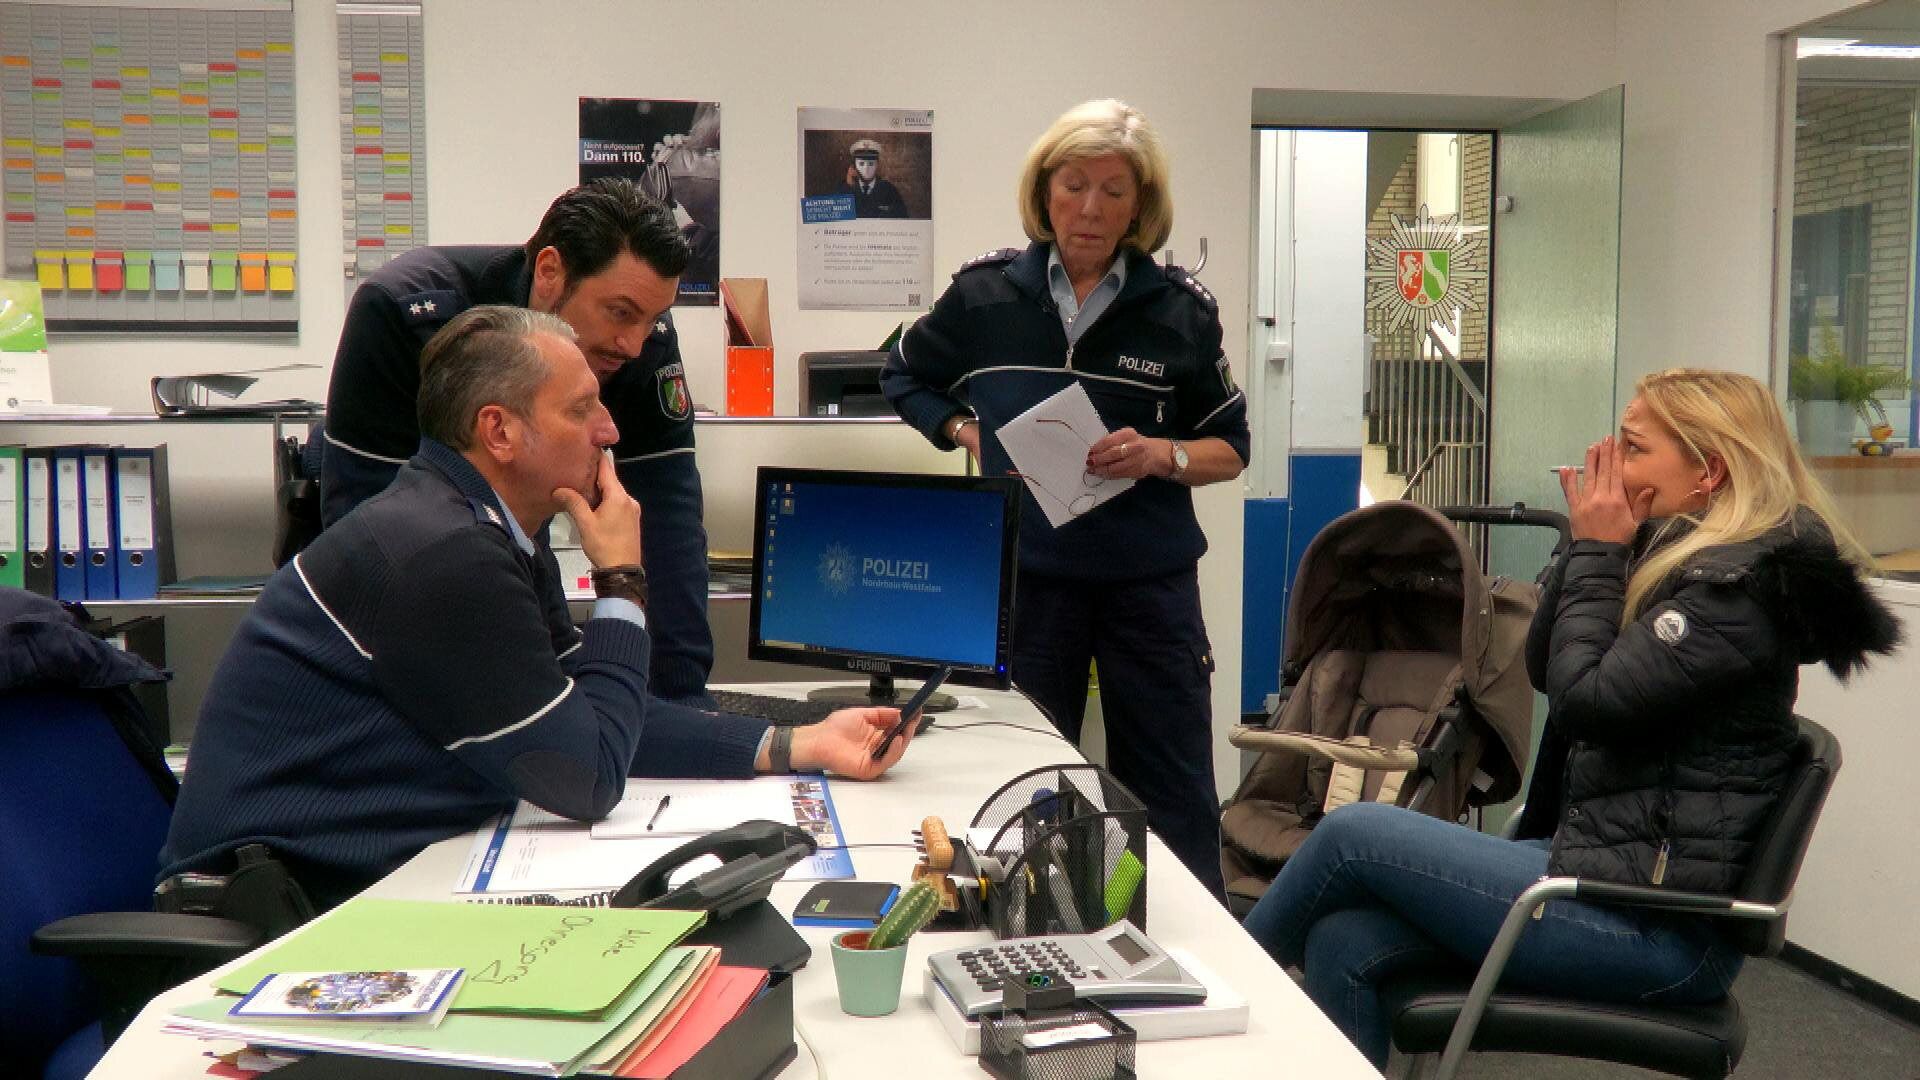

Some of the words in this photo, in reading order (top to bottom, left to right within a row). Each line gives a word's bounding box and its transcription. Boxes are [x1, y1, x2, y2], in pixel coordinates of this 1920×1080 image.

[584, 150, 618, 161] Dann
[621, 151, 645, 162] 110.
[1118, 354, 1165, 377] POLIZEI
[862, 557, 929, 580] POLIZEI
[856, 659, 891, 673] FUSHIDA
